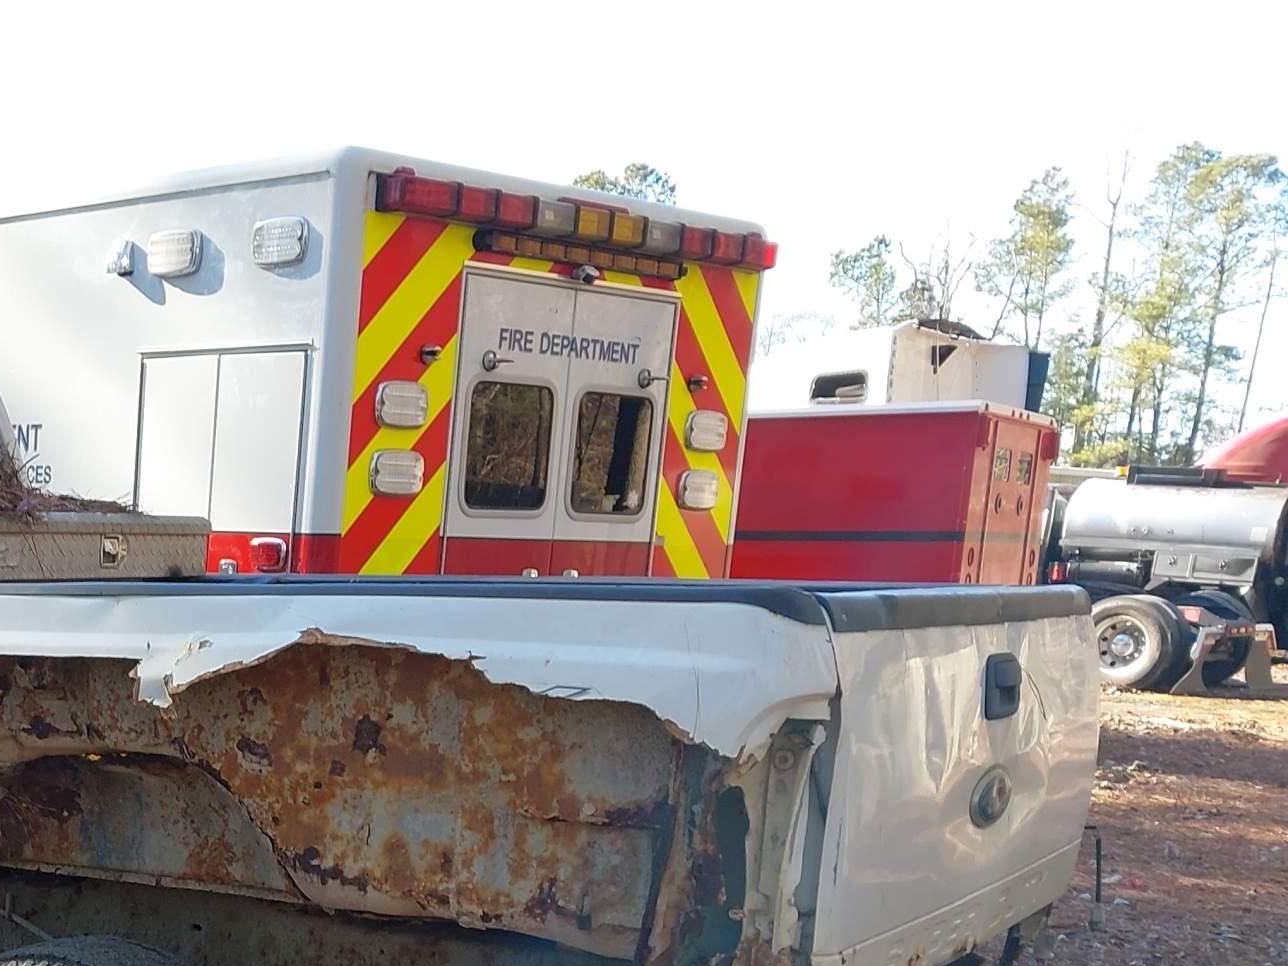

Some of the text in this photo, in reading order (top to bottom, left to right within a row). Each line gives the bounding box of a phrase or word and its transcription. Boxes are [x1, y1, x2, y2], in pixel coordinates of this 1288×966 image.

[498, 327, 640, 364] FIRE DEPARTMENT
[12, 423, 42, 452] NT
